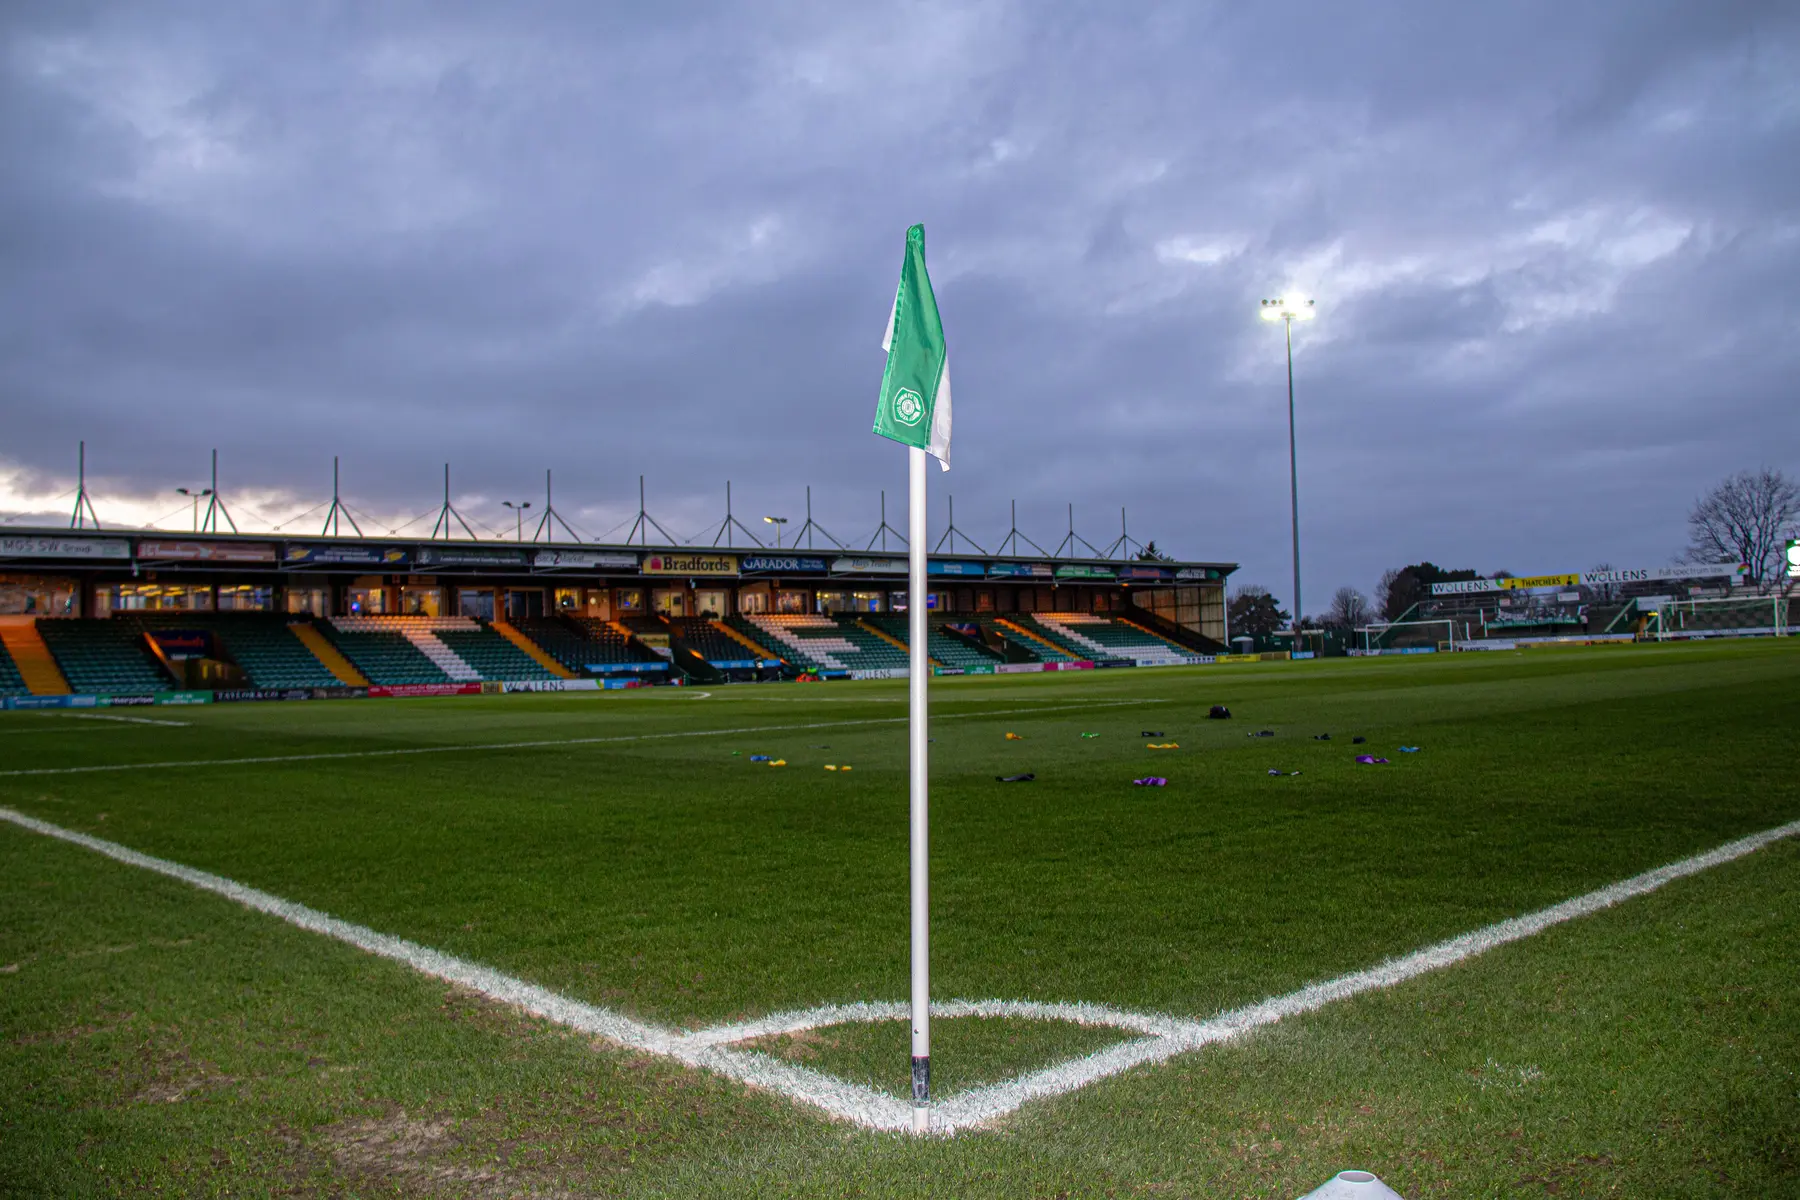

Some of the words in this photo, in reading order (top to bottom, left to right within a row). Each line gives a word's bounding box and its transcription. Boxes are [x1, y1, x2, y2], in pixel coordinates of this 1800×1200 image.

[663, 557, 730, 572] Bradfords
[743, 558, 799, 570] GARADOR
[1584, 569, 1648, 583] WOLLENS
[1659, 568, 1671, 577] Full
[1673, 566, 1708, 577] spectrum
[1433, 581, 1489, 593] WOLLENS
